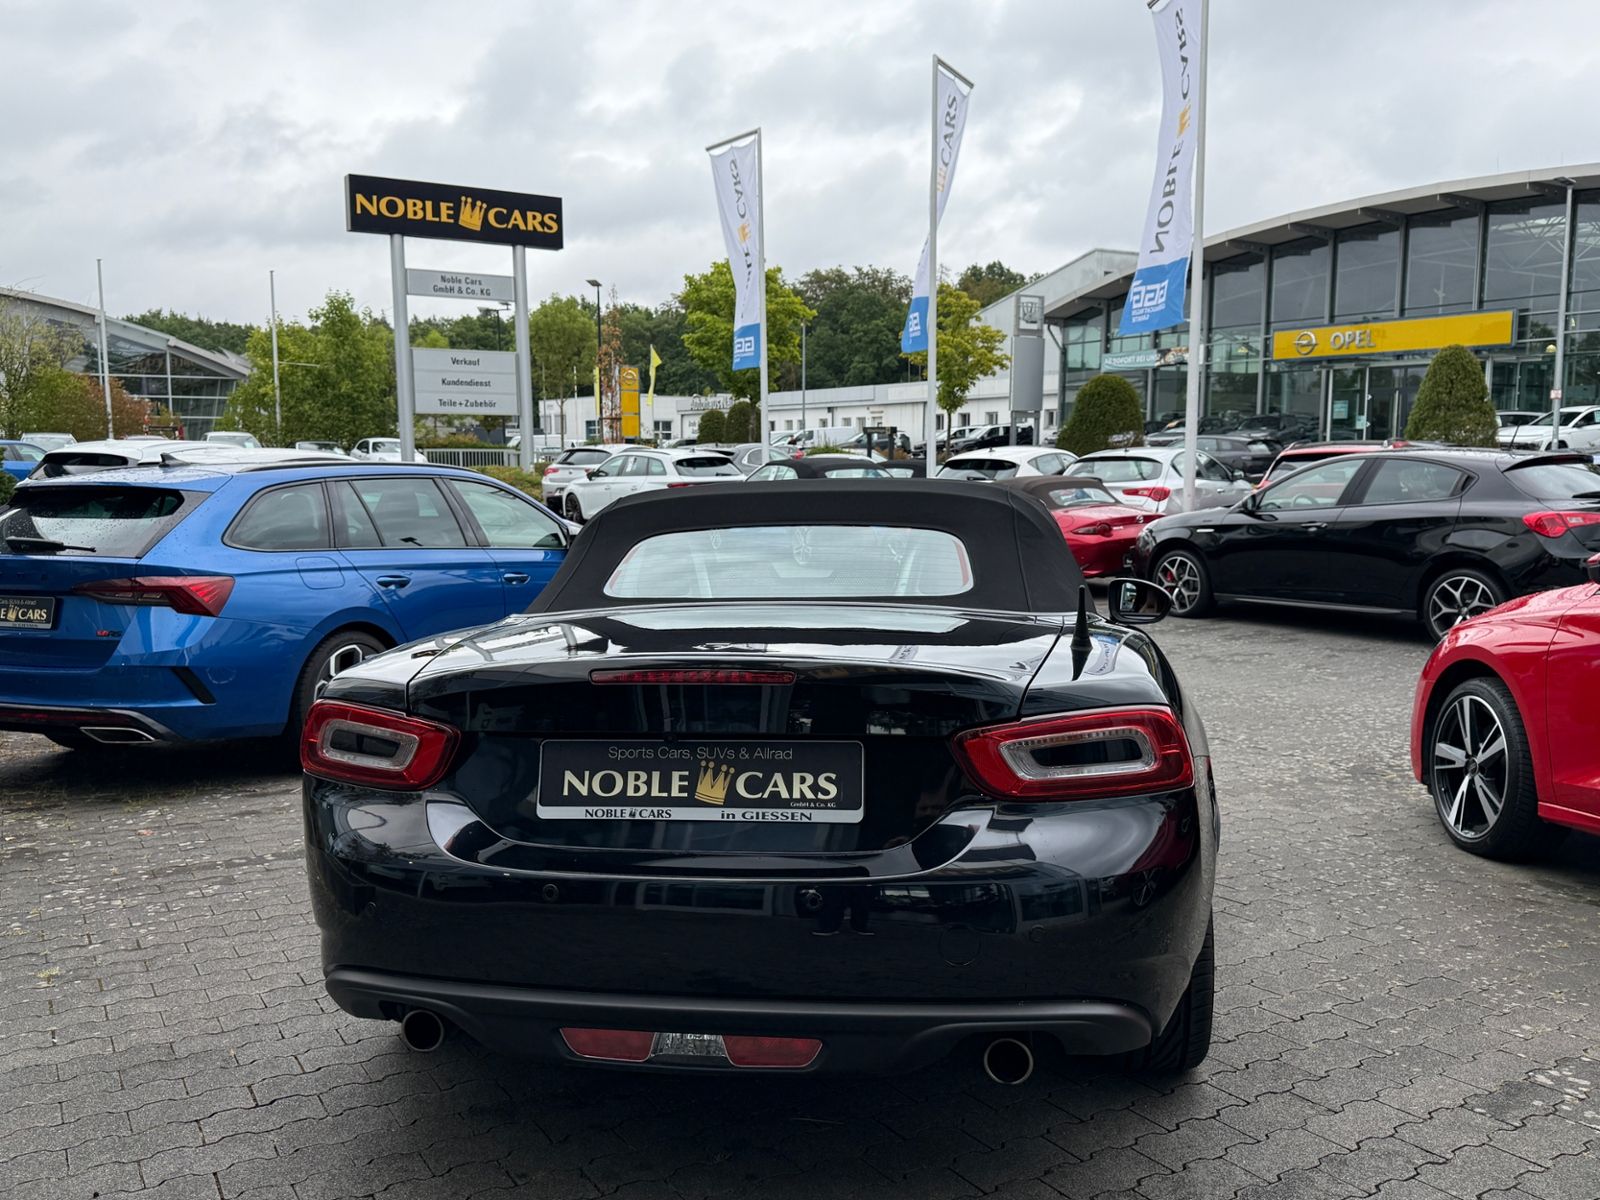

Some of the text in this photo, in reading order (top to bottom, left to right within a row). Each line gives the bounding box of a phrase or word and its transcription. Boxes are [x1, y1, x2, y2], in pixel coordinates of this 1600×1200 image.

[941, 94, 958, 167] CARS
[355, 193, 559, 234] NOBLE CARS
[440, 274, 482, 286] Noble Cars
[432, 284, 491, 296] GmbH & Co. KG
[1330, 330, 1376, 350] OPEL
[450, 357, 480, 366] Verkauf
[441, 378, 491, 387] Kundendienst
[18, 608, 47, 621] CARS
[608, 746, 793, 761] Sports Cars, SUVs & Allrad
[562, 770, 838, 800] NOBLE CARS
[584, 808, 672, 819] NOBLE CARS
[720, 810, 812, 821] in GIESSEN
